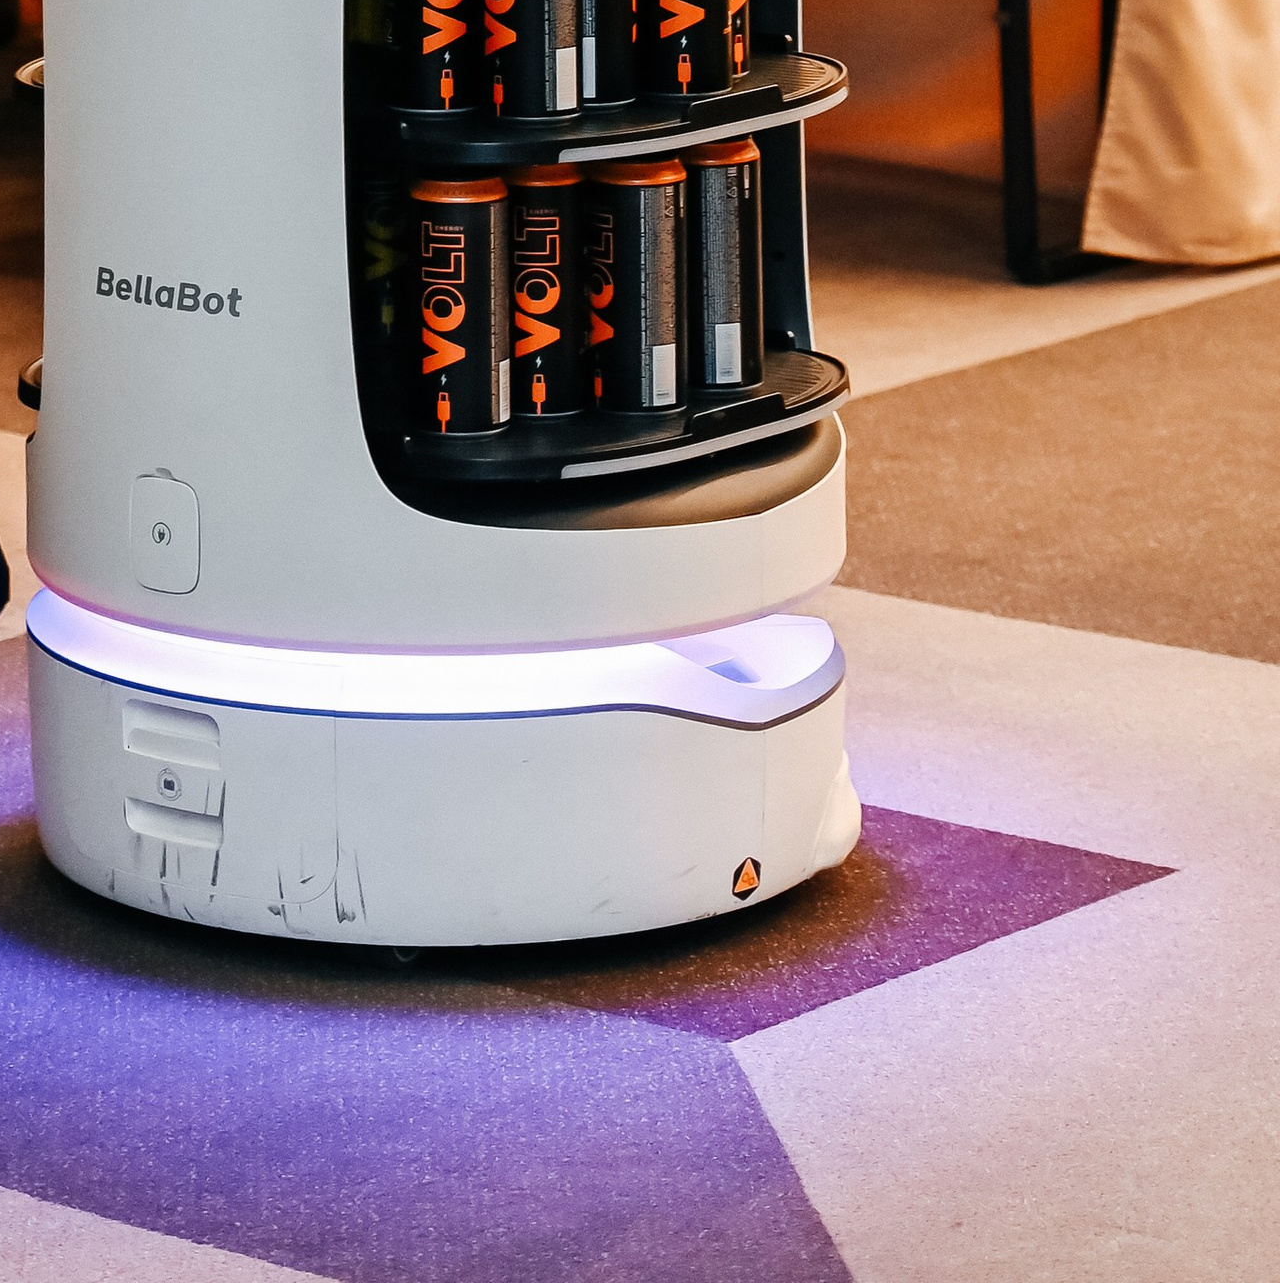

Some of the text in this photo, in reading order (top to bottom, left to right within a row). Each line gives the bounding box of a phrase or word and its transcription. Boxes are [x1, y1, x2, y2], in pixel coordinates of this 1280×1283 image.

[96, 266, 242, 317] BellaBot
[422, 221, 466, 375] VOLT
[514, 206, 561, 358] VOLT
